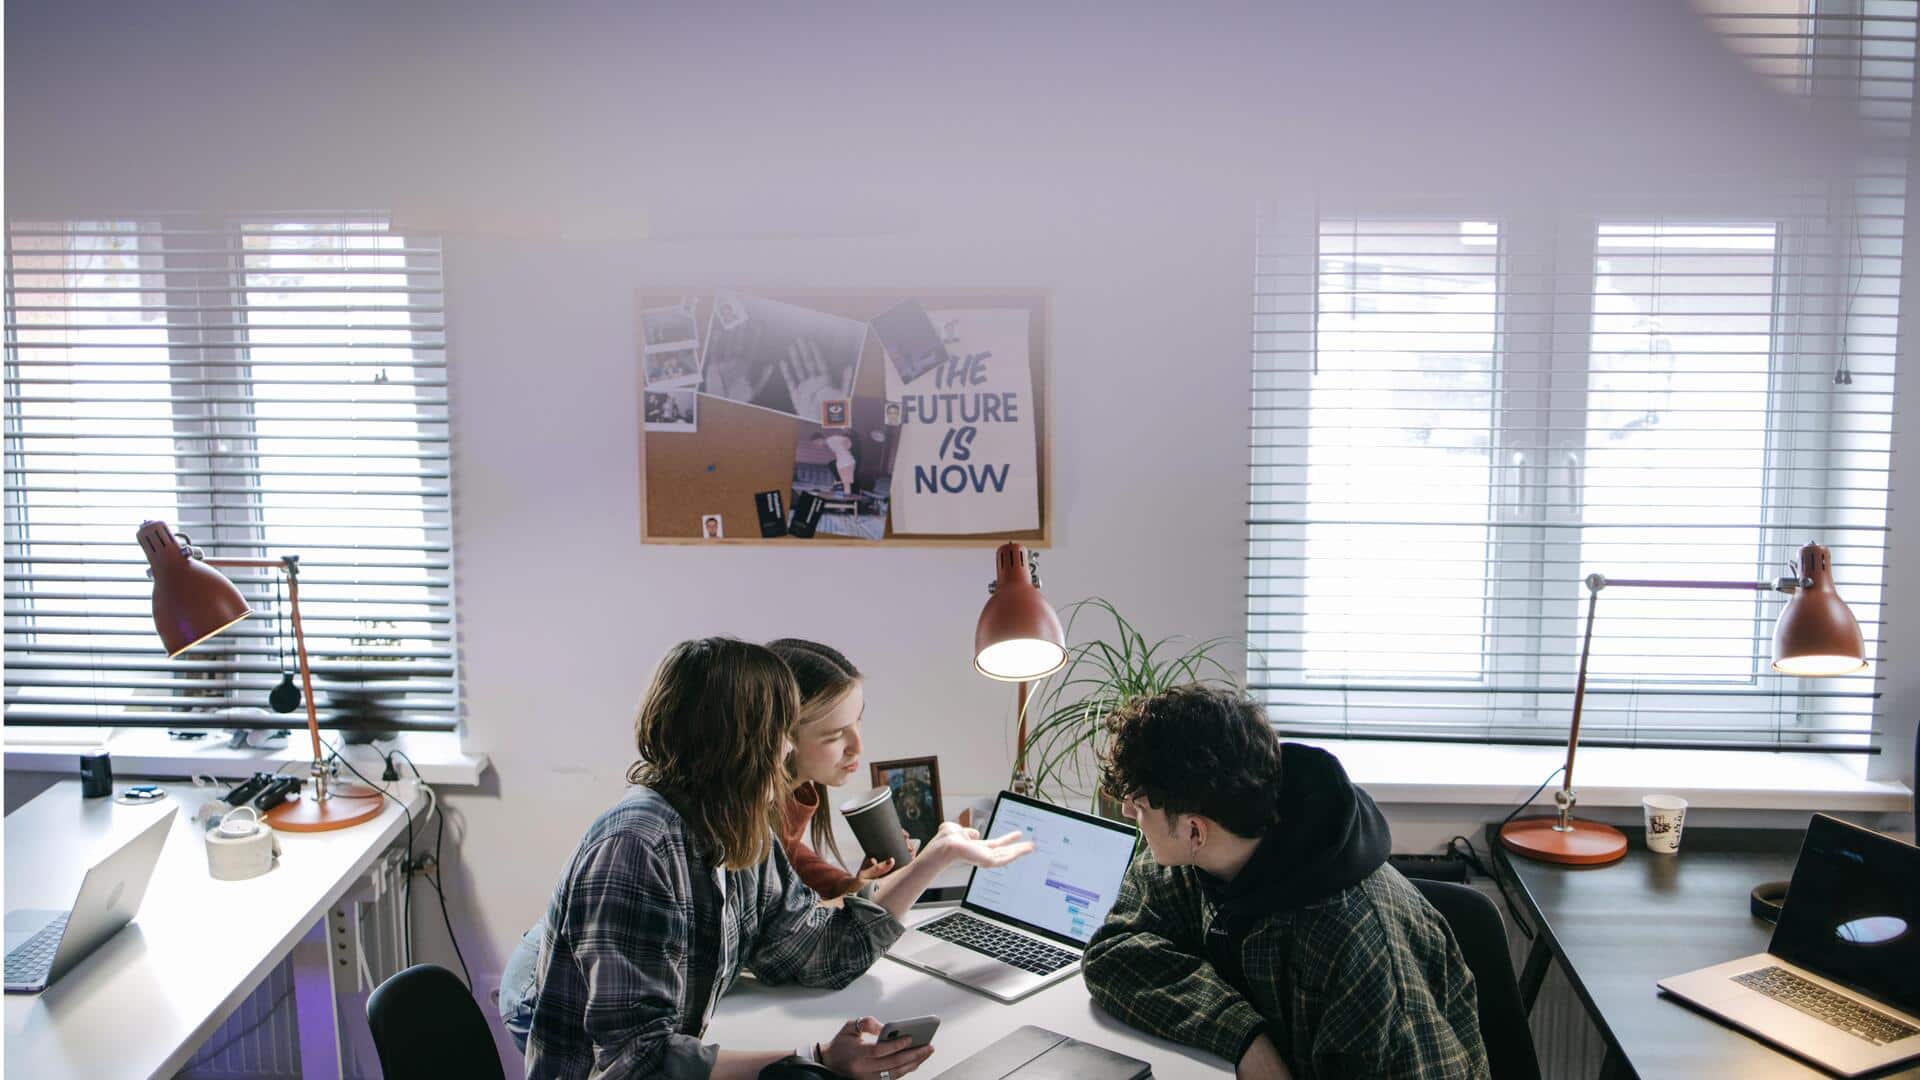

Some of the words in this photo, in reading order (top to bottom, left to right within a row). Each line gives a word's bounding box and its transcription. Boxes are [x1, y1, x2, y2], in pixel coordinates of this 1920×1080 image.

[902, 392, 1018, 424] FUTURE
[939, 426, 977, 461] IS
[915, 463, 1010, 494] NOW
